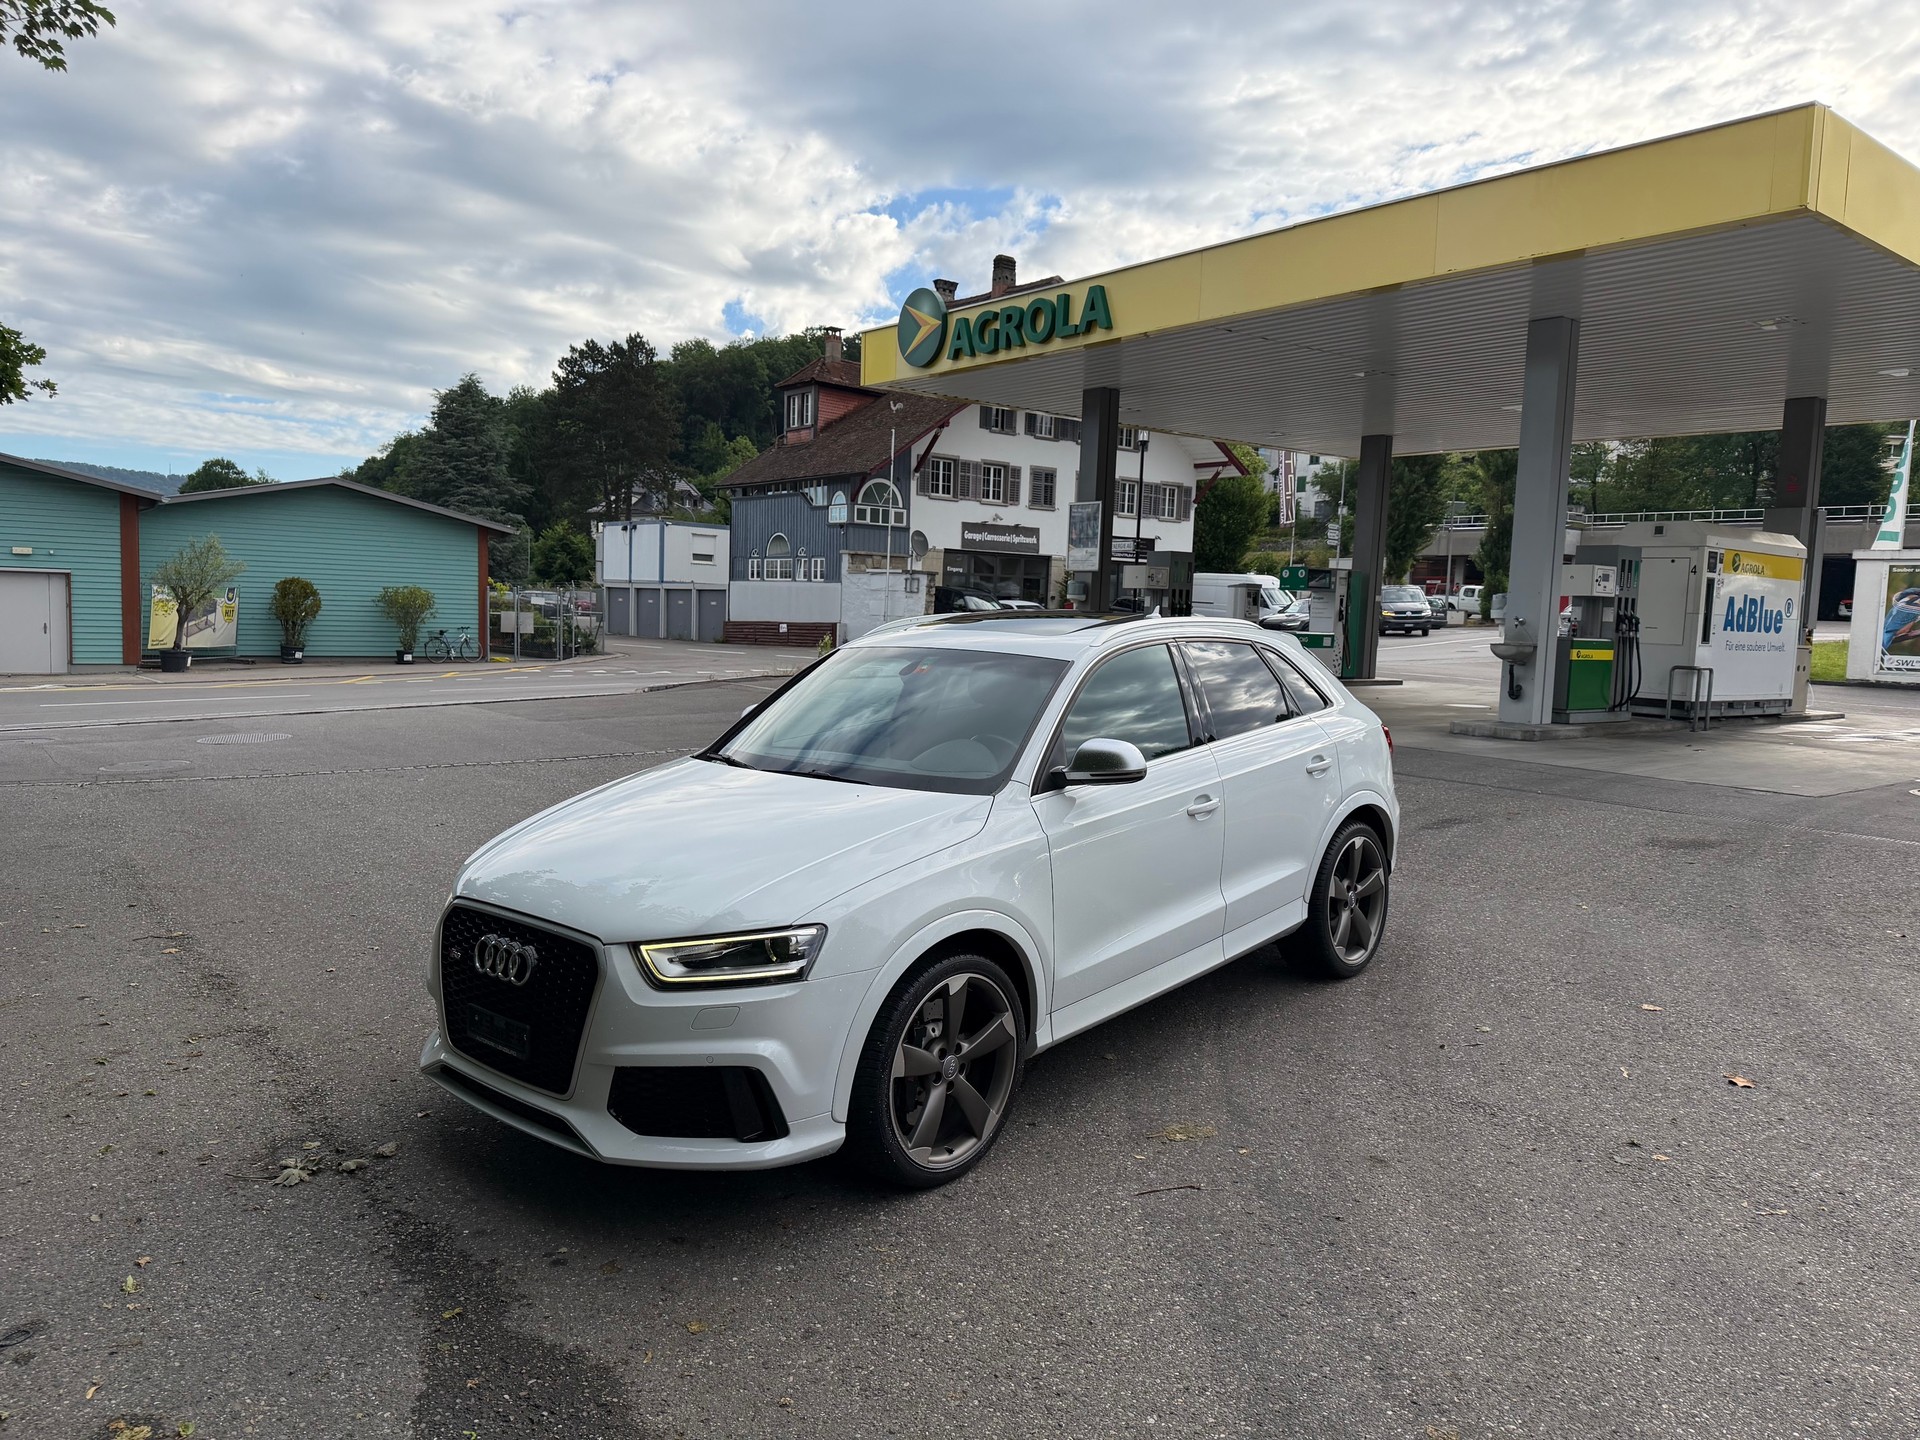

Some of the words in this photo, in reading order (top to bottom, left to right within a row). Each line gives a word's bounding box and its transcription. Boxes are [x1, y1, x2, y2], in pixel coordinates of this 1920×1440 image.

[946, 284, 1113, 361] AGROLA
[964, 530, 982, 541] Garage
[984, 532, 1011, 543] Carrosserie
[1012, 534, 1037, 544] Spritzwerk
[1690, 565, 1697, 575] 4
[1740, 563, 1765, 575] AGROLA
[224, 609, 235, 617] HIT
[1725, 640, 1734, 651] Für
[1734, 642, 1746, 652] eine
[1746, 641, 1766, 652] saubere
[1894, 659, 1916, 667] SWL
